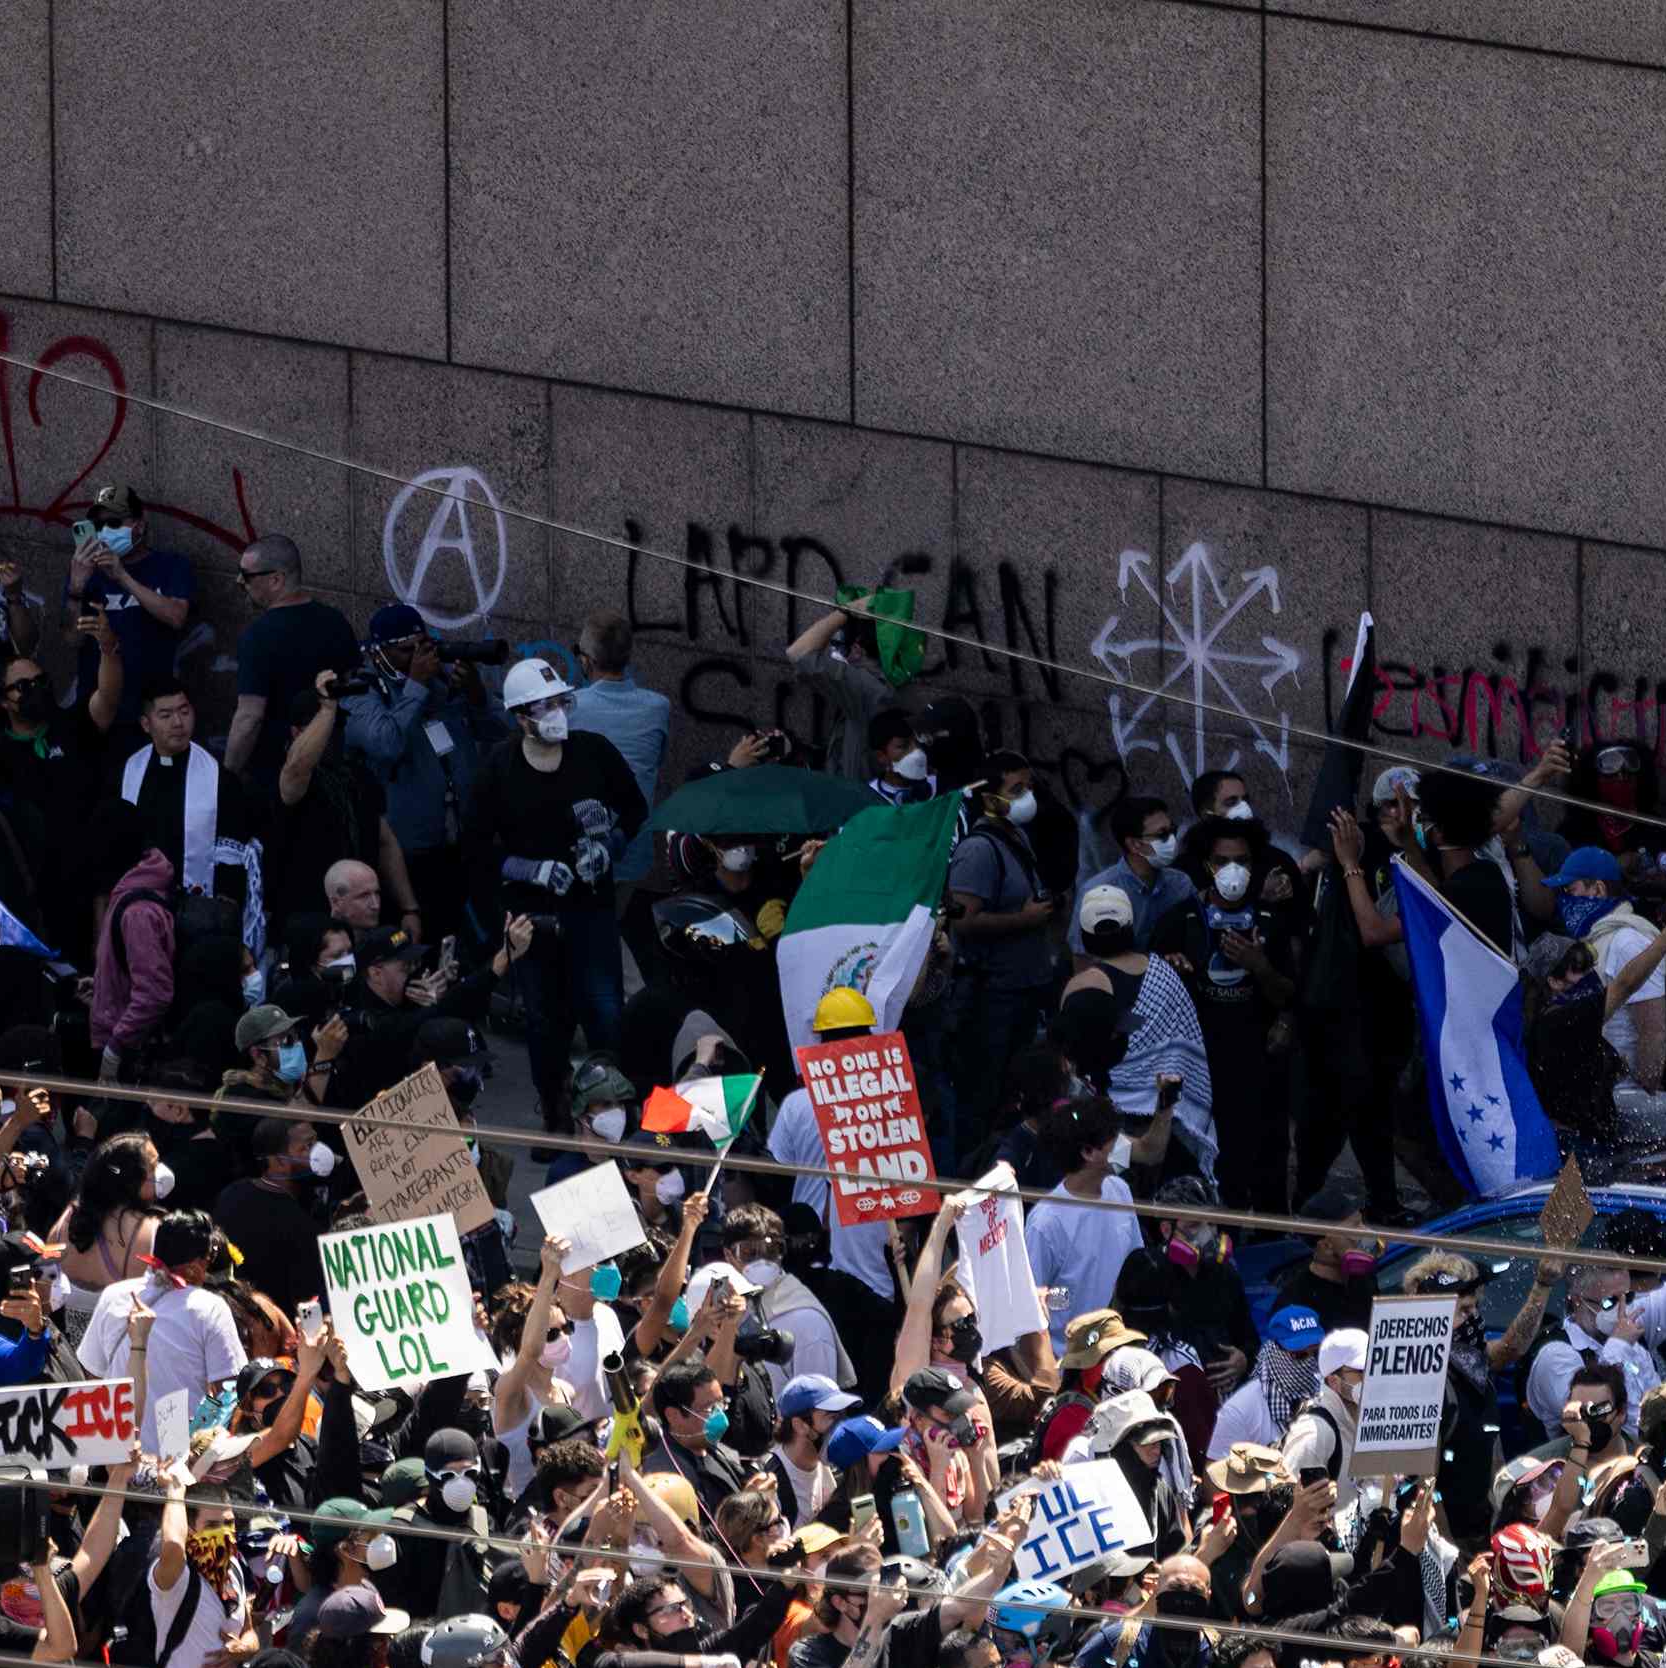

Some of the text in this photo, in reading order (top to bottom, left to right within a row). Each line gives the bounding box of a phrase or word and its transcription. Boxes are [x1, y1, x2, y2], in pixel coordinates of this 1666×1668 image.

[807, 1046, 903, 1080] NO ONE IS
[809, 1073, 912, 1106] ILLEGAL
[855, 1101, 883, 1122] ON
[828, 1116, 920, 1155] STOLEN
[834, 1149, 929, 1198] LAND
[322, 1222, 456, 1291] NATIONAL
[352, 1279, 449, 1337] GUARD
[1373, 1315, 1450, 1345] ¡DERECHOS
[375, 1331, 450, 1381] LOL
[1369, 1343, 1446, 1377] PLENOS
[63, 1384, 134, 1443] ICE
[1359, 1417, 1437, 1443] INMIGRANTES!
[1362, 1403, 1439, 1423] PARA TODOS LOS
[1022, 1505, 1126, 1581] ICE
